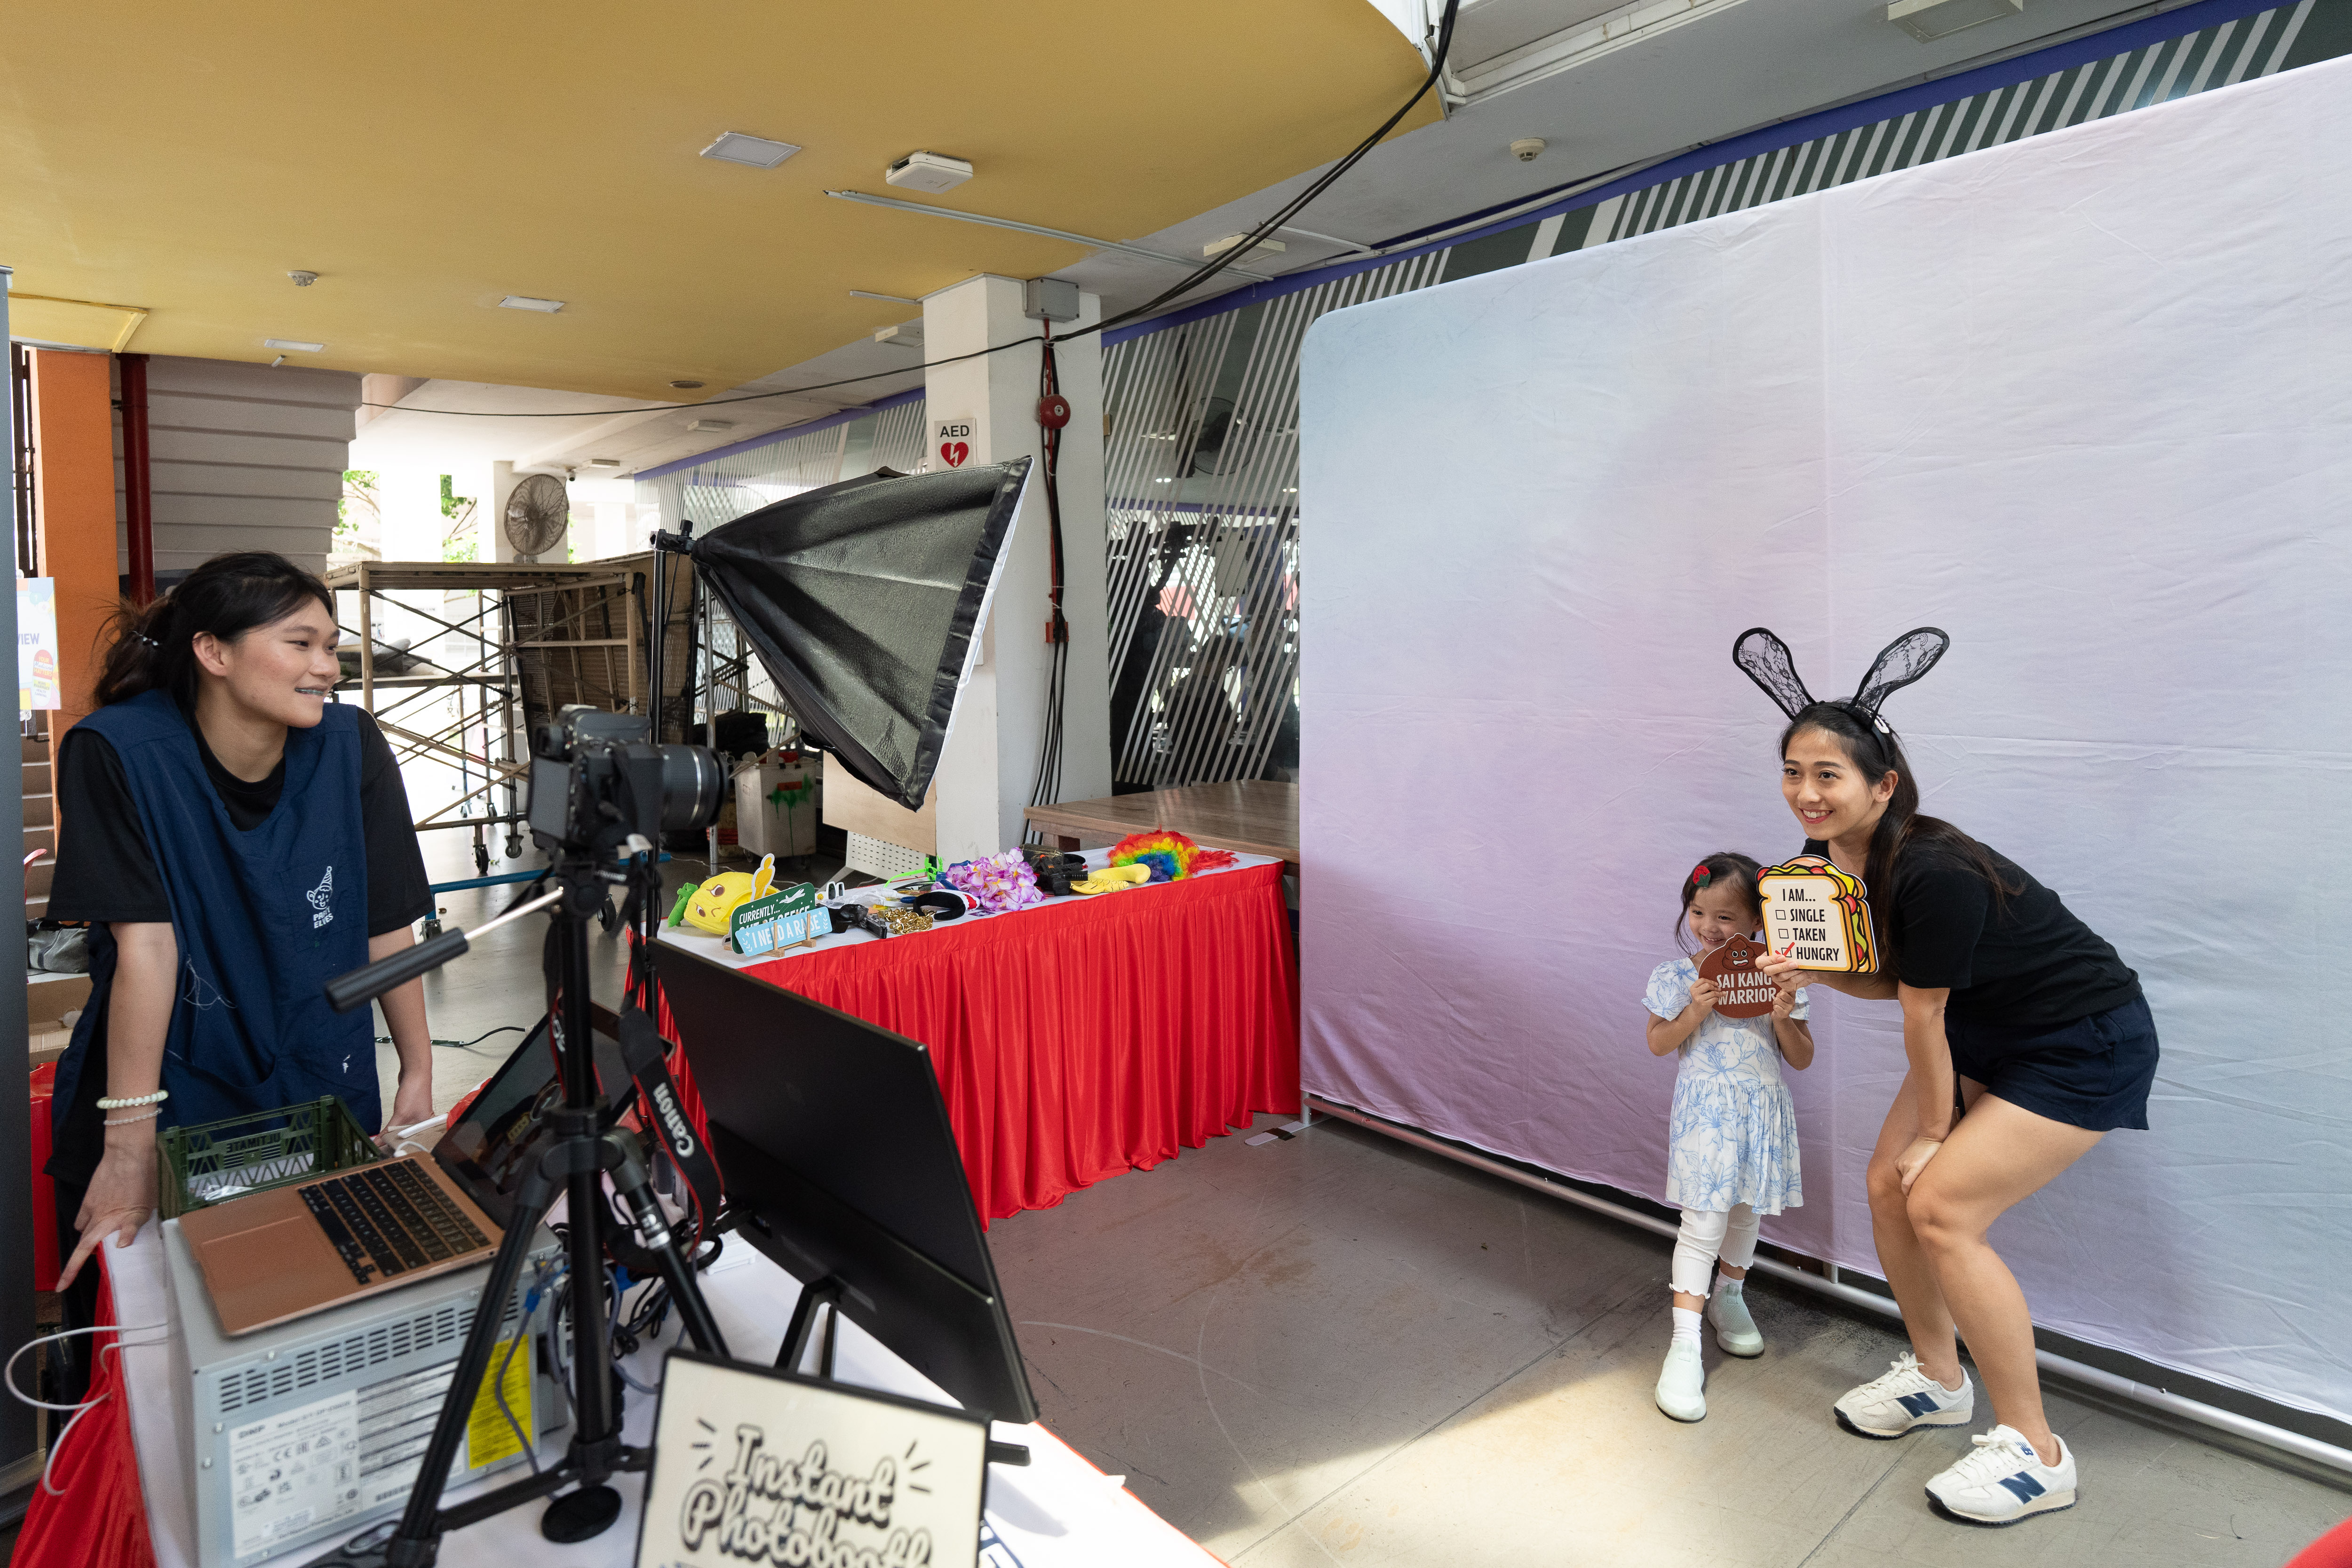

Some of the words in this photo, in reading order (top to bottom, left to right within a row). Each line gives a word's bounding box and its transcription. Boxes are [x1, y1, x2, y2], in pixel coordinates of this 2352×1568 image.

[940, 425, 969, 438] AED
[33, 667, 52, 677] MATTERS
[34, 661, 53, 670] Medicine
[1783, 889, 1786, 901] I
[1788, 889, 1815, 901] AM...
[739, 904, 780, 924] CURRENTLY...
[1790, 909, 1825, 922] SINGLE
[752, 932, 757, 948] I
[786, 923, 794, 938] A
[793, 914, 821, 936] RASE
[1793, 928, 1826, 941] TAKEN
[1796, 947, 1839, 961] HUNGRY
[1716, 974, 1734, 988] SAI
[1738, 971, 1772, 987] KANG
[1718, 987, 1776, 1005] WARRIOR
[653, 1082, 694, 1158] Canon
[723, 1424, 898, 1528] Instant
[681, 1478, 932, 1568] Photobooth
